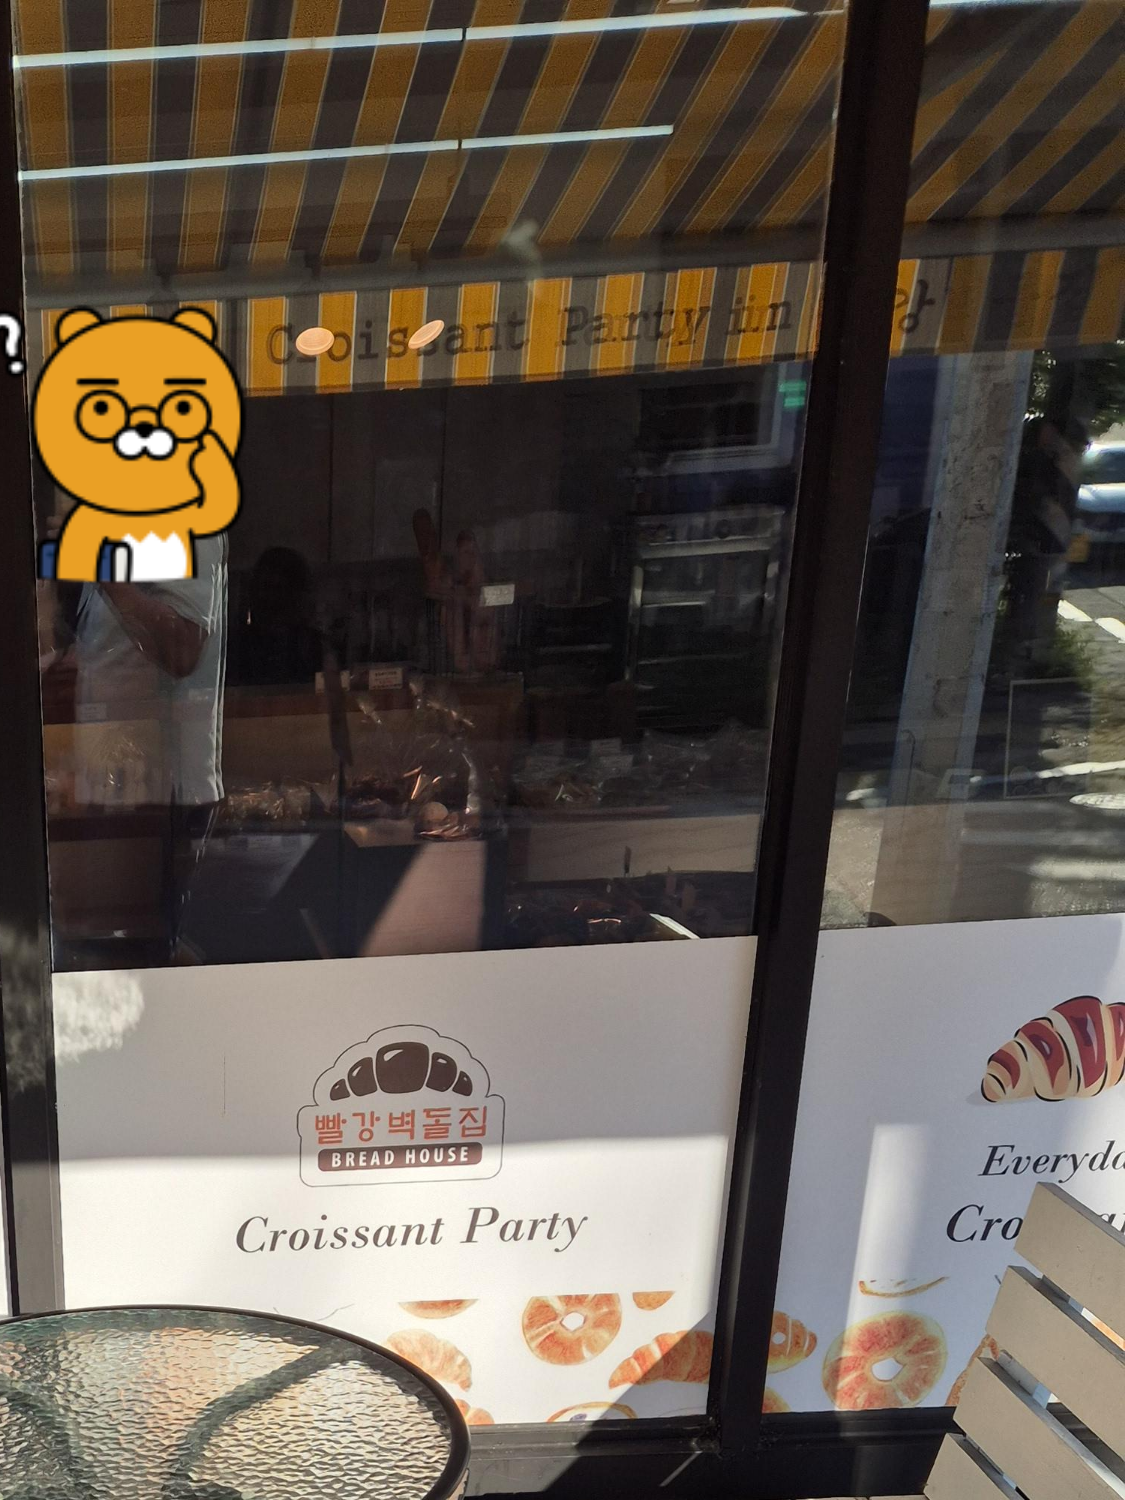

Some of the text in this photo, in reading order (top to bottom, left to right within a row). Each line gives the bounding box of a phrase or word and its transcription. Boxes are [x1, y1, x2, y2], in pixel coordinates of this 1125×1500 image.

[266, 309, 530, 365] Coisant
[559, 304, 712, 348] Party
[315, 1106, 488, 1145] 빨강벽돌집
[332, 1147, 469, 1168] BREAD HOUSE
[235, 1206, 588, 1253] Croissant Party
